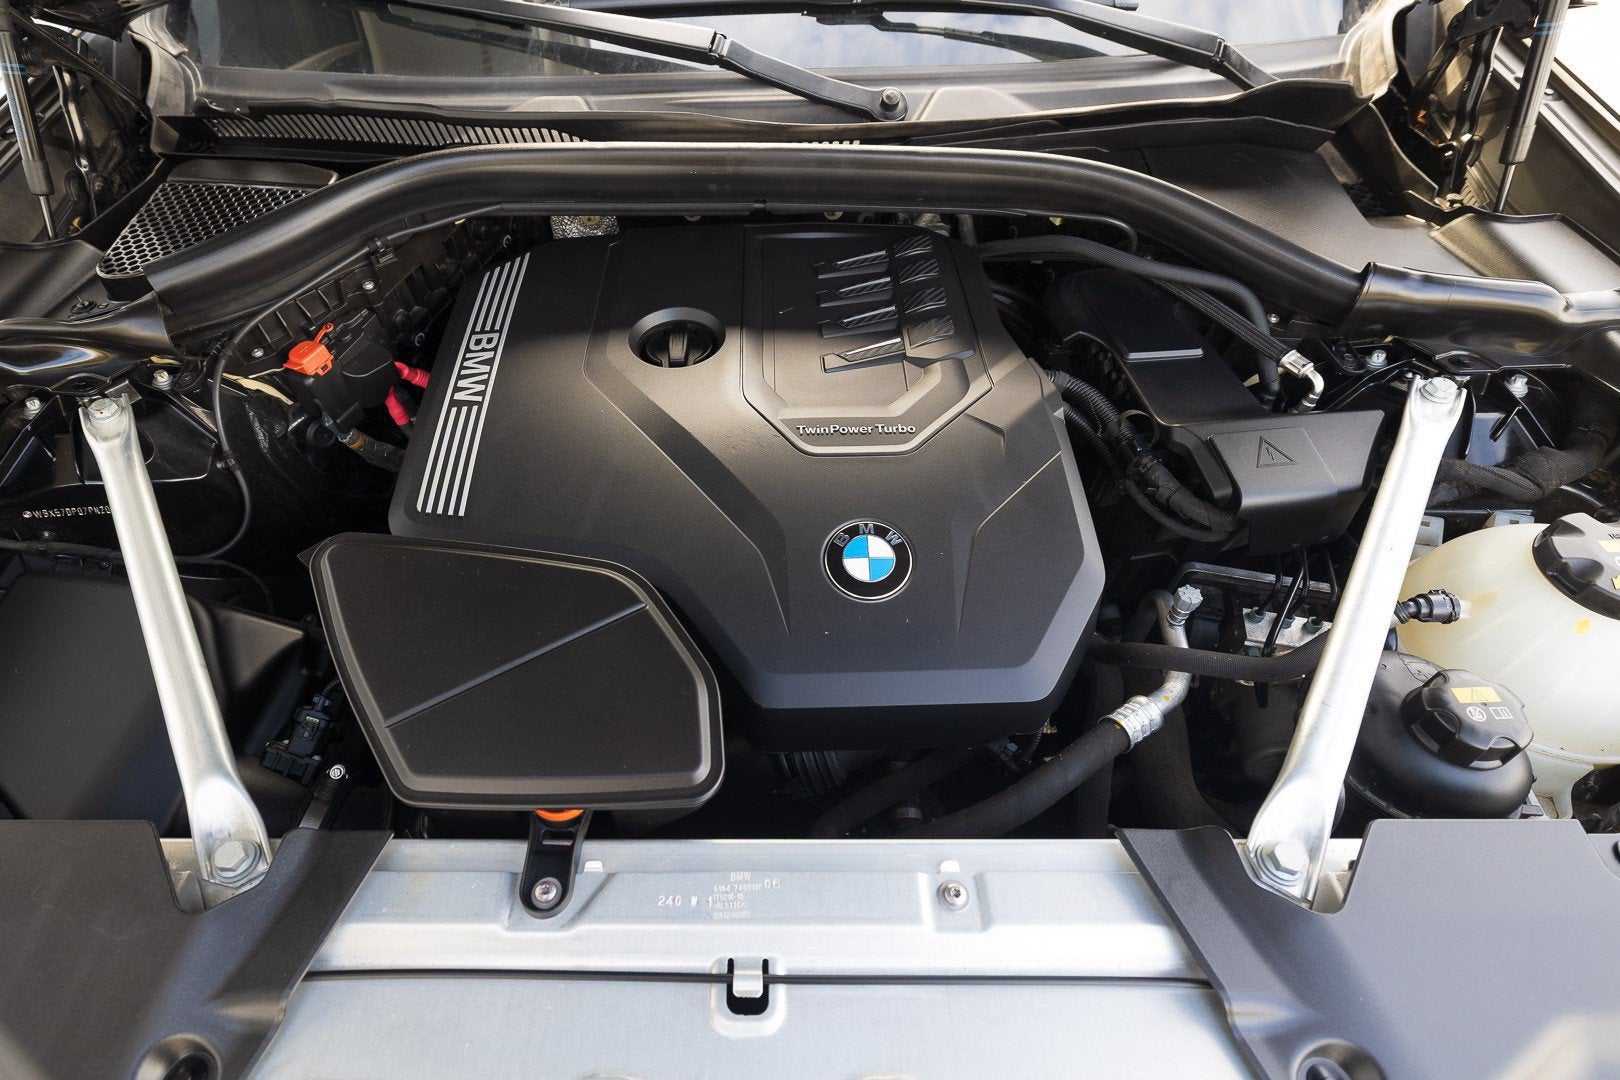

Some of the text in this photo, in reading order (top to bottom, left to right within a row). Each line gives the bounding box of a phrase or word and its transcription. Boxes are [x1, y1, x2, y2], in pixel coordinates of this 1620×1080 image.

[453, 332, 500, 402] BMW
[875, 423, 916, 434] Turbo
[833, 523, 903, 547] BMW
[730, 872, 751, 882] BMW
[657, 895, 682, 907] 240
